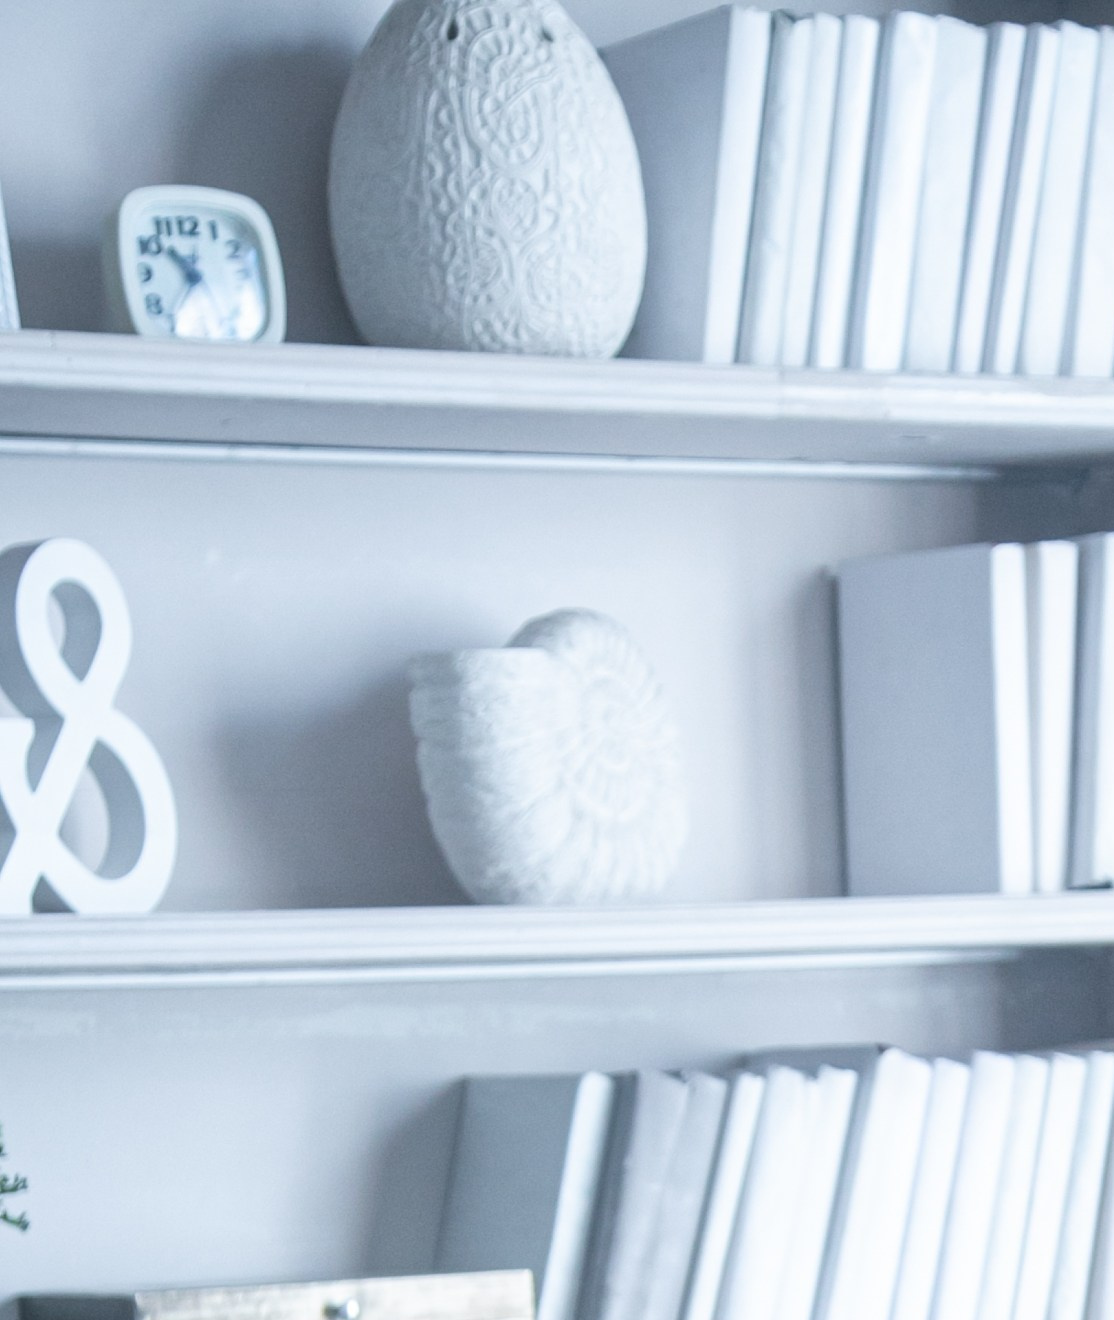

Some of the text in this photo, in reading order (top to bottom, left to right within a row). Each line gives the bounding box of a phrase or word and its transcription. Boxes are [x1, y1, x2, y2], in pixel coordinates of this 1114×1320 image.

[153, 216, 172, 237] 11
[175, 216, 200, 236] 12
[208, 220, 218, 241] 1
[137, 235, 162, 255] 10
[227, 239, 242, 259] 2
